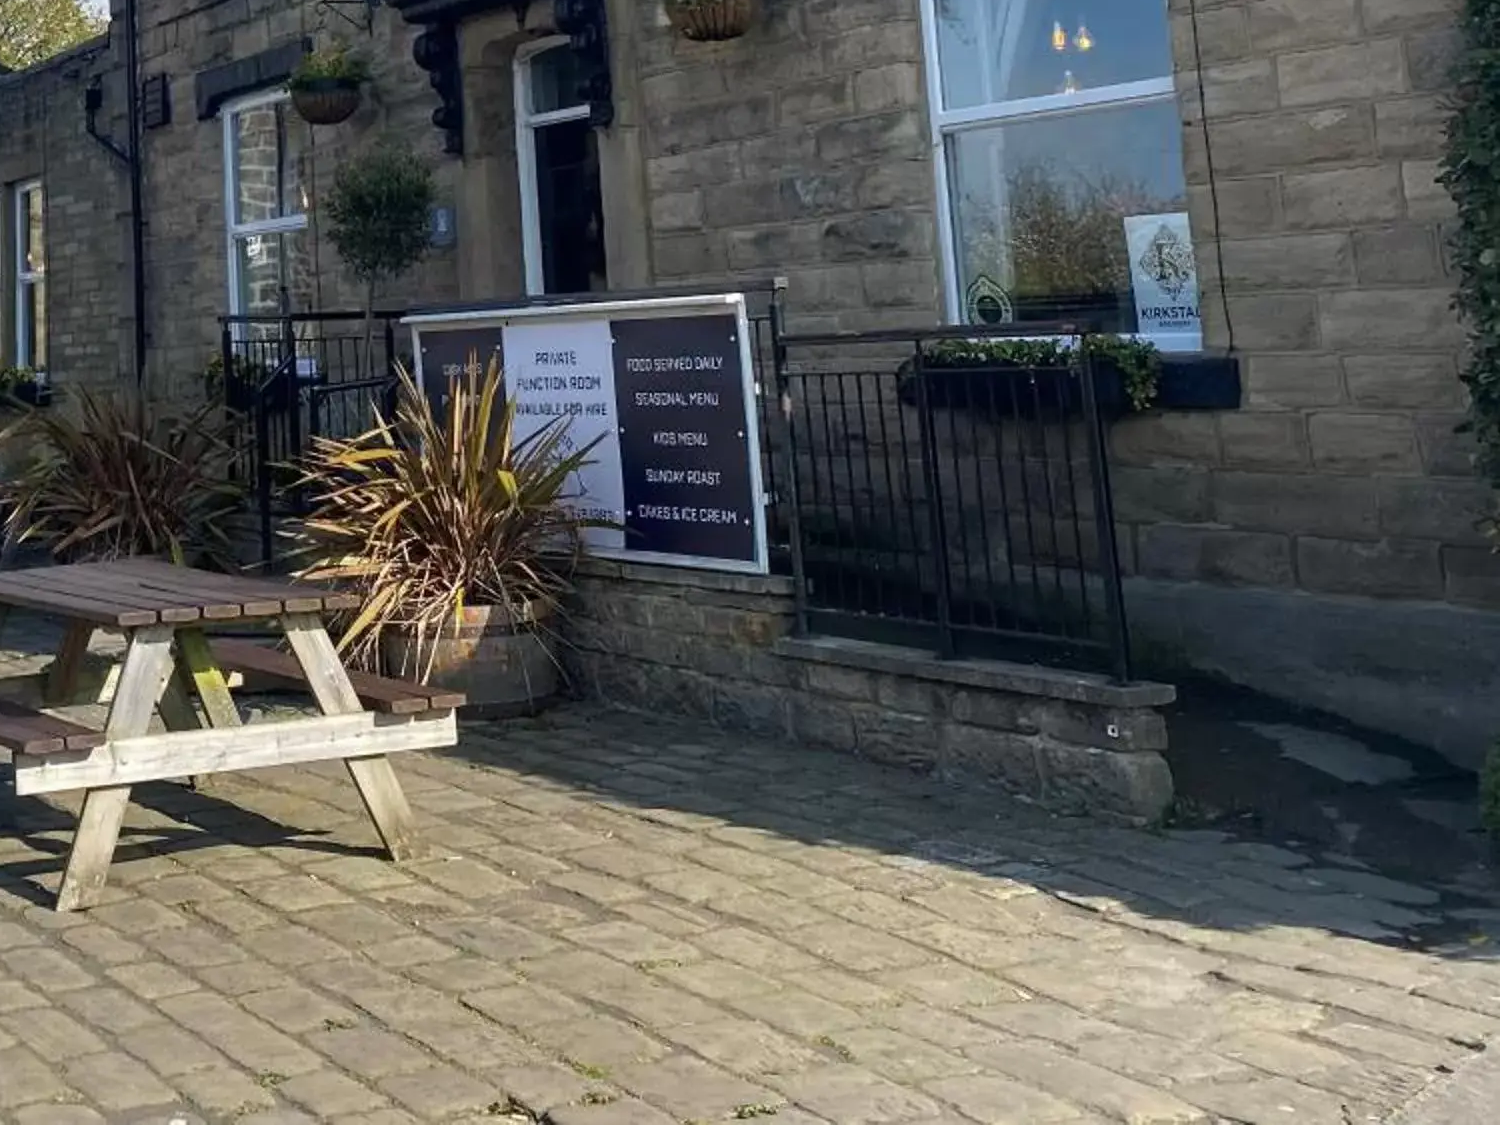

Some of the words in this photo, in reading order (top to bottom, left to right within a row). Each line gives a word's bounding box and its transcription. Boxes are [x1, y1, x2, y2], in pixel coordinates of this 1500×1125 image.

[535, 351, 577, 366] PRIVATE
[626, 358, 652, 372] FOOD
[654, 356, 692, 371] SERVED
[695, 356, 723, 370] DAILY
[516, 377, 567, 391] FUNCTION
[569, 375, 601, 390] ROOM
[635, 392, 688, 406] SEASONAL
[689, 392, 719, 406] MENU
[585, 402, 608, 416] HIRE
[653, 432, 676, 446] KIDS
[678, 432, 708, 446] MENU
[645, 468, 685, 483] SUNDAY
[687, 469, 721, 485] ROAST
[638, 504, 669, 520] CAKES
[671, 506, 680, 520] &
[681, 507, 698, 522] ICE
[699, 508, 738, 524] CREAM
